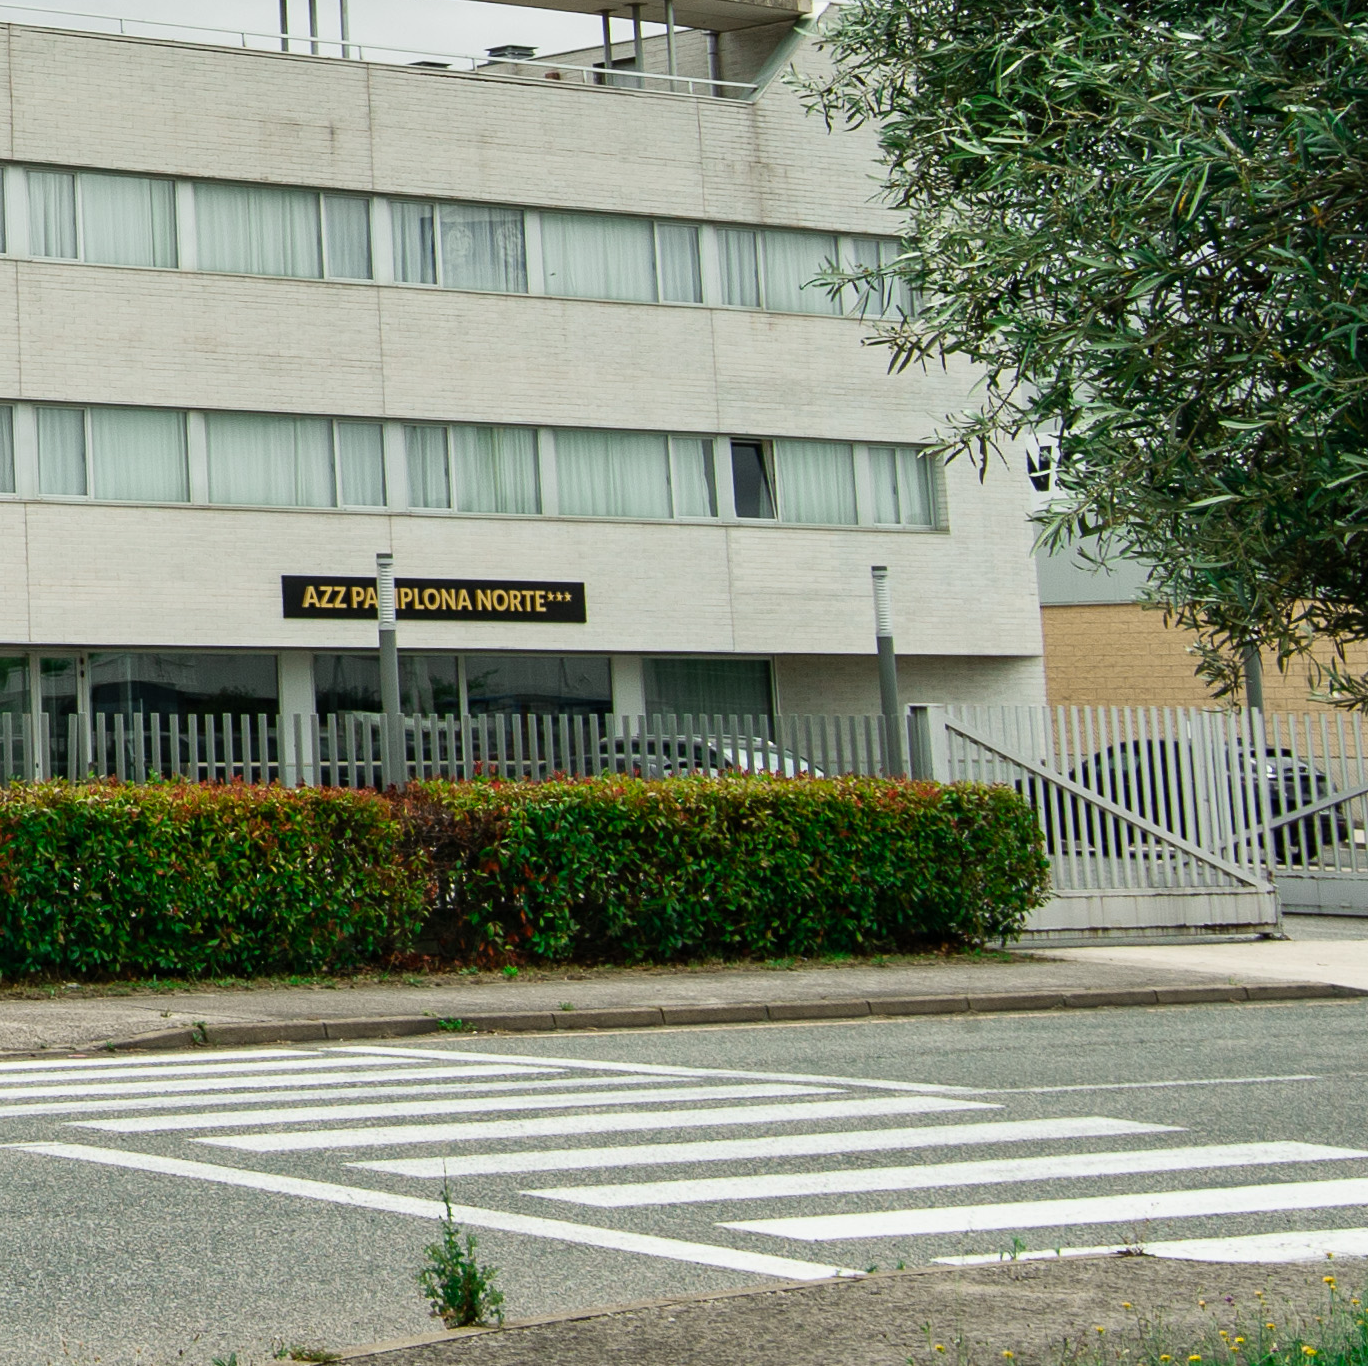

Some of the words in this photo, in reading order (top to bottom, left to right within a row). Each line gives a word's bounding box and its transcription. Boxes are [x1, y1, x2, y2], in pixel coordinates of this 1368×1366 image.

[302, 585, 348, 609] AZZ
[350, 586, 473, 611] PAPLONA
[474, 589, 547, 612] NORTE
